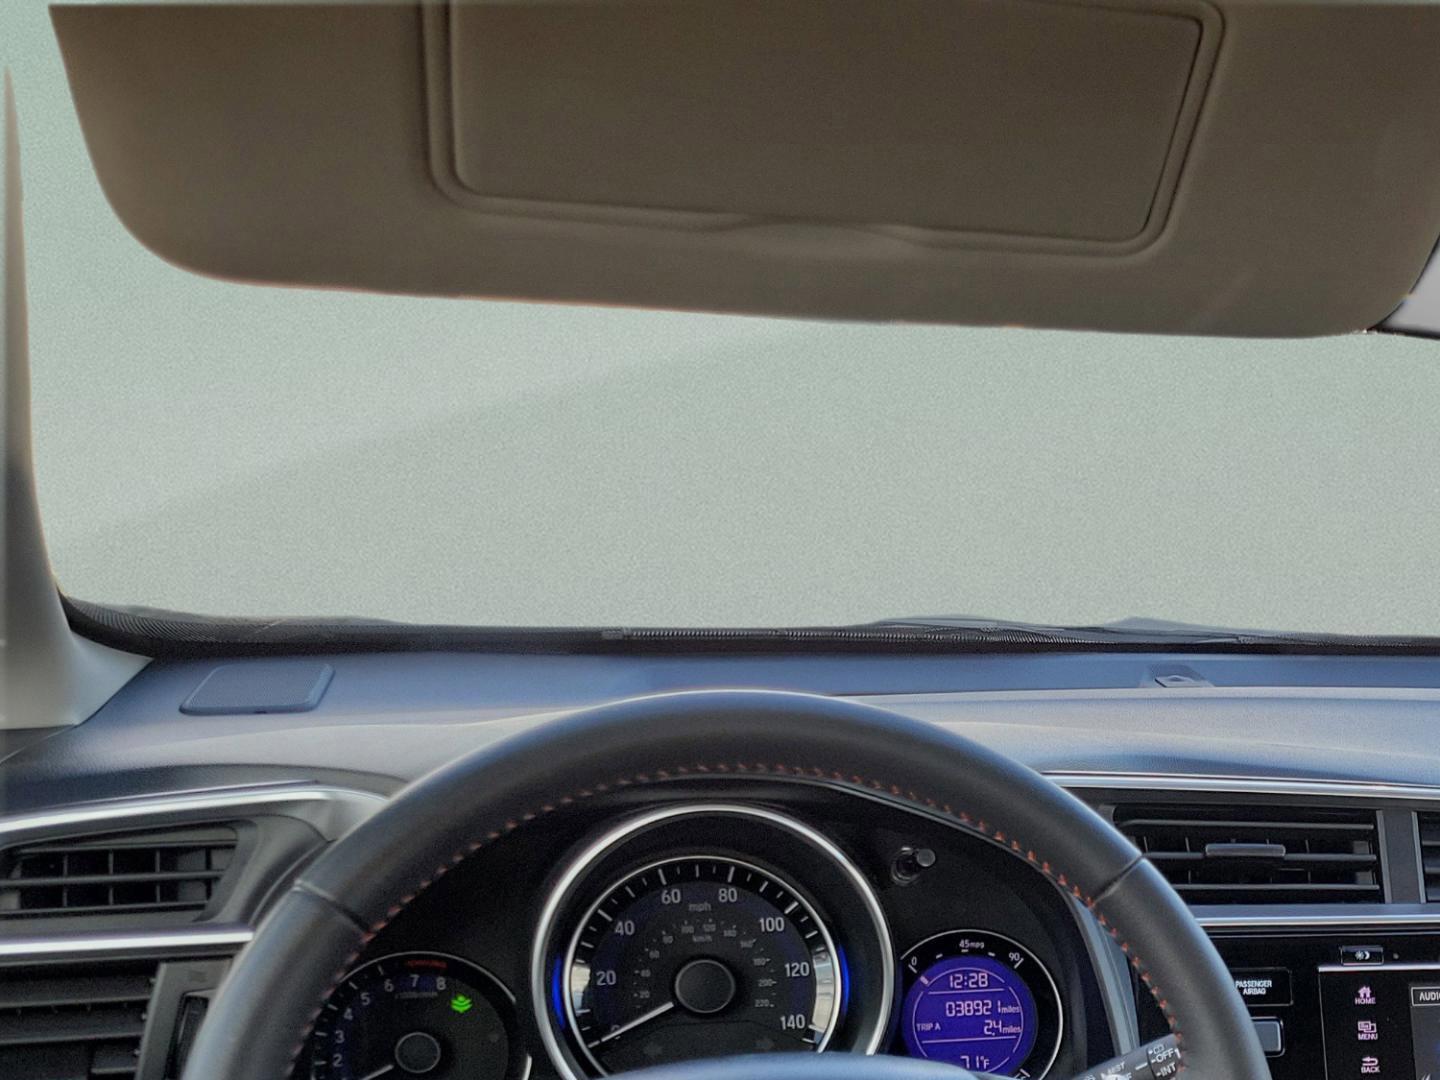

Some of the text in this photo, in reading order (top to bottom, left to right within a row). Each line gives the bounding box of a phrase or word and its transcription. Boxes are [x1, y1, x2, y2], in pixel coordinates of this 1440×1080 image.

[661, 888, 681, 904] 60
[718, 888, 738, 903] 80
[688, 903, 712, 912] mph
[615, 920, 635, 936] 40
[759, 917, 785, 932] 100
[1008, 952, 1020, 961] 90
[784, 961, 810, 977] 120
[409, 974, 420, 988] 7
[436, 976, 447, 990] 8
[596, 970, 616, 986] 20
[949, 972, 989, 989] 12:28
[1235, 980, 1272, 989] PASSENGER
[384, 979, 394, 992] 6
[1243, 987, 1266, 995] AIRBAG
[360, 992, 371, 1006] 5
[1355, 997, 1376, 1005] HOME
[780, 1014, 806, 1030] 140
[334, 1030, 345, 1044] 3
[332, 1054, 343, 1067] 2
[1361, 1066, 1380, 1074] BACK
